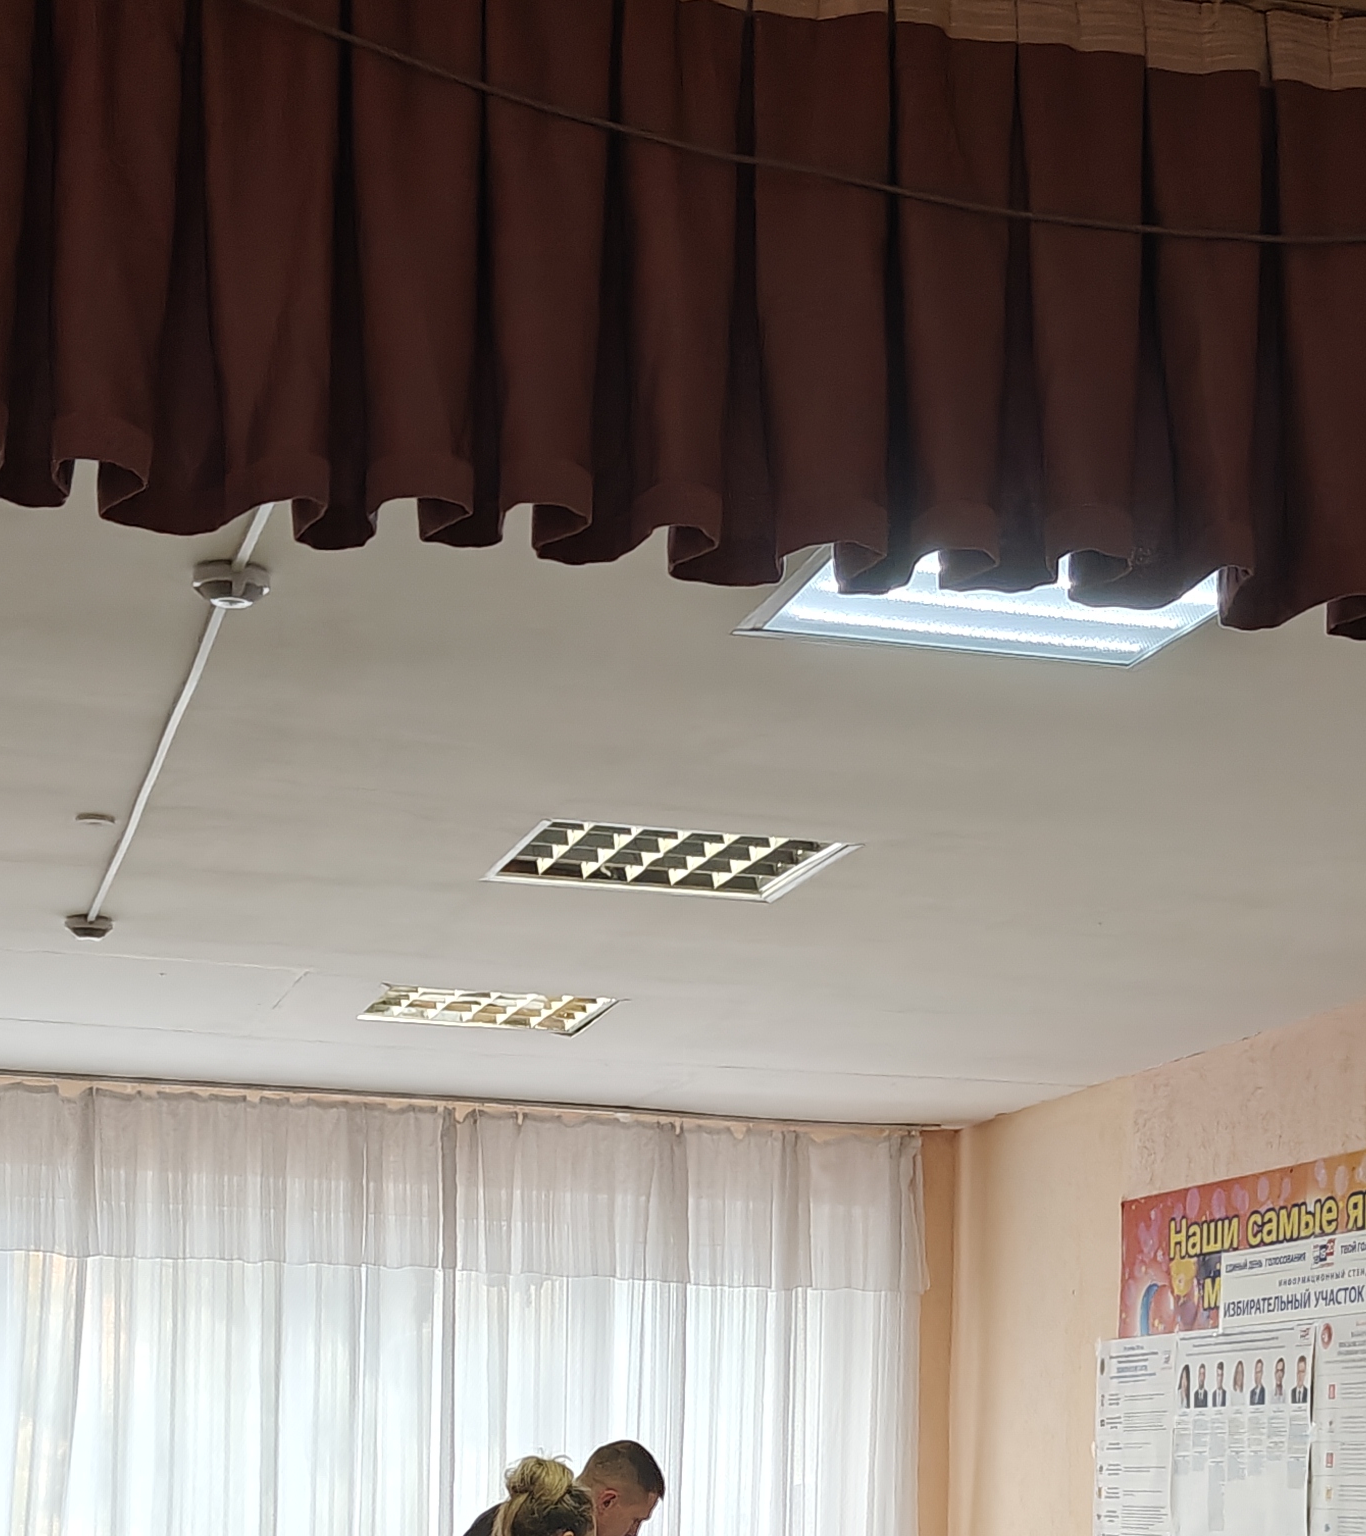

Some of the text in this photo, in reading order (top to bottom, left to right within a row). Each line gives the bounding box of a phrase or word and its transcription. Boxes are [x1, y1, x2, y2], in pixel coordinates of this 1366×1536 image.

[1169, 1215, 1239, 1260] Наши
[1247, 1195, 1339, 1247] самые
[1265, 1252, 1306, 1267] ГОЛОСОВАНИЯ
[1278, 1269, 1345, 1287] ИНФОРМАЦИОННЫЙ
[1223, 1289, 1311, 1318] ИЗБИРАТЕЛЬНЫЙ
[1313, 1285, 1365, 1311] УЧАСТОК
